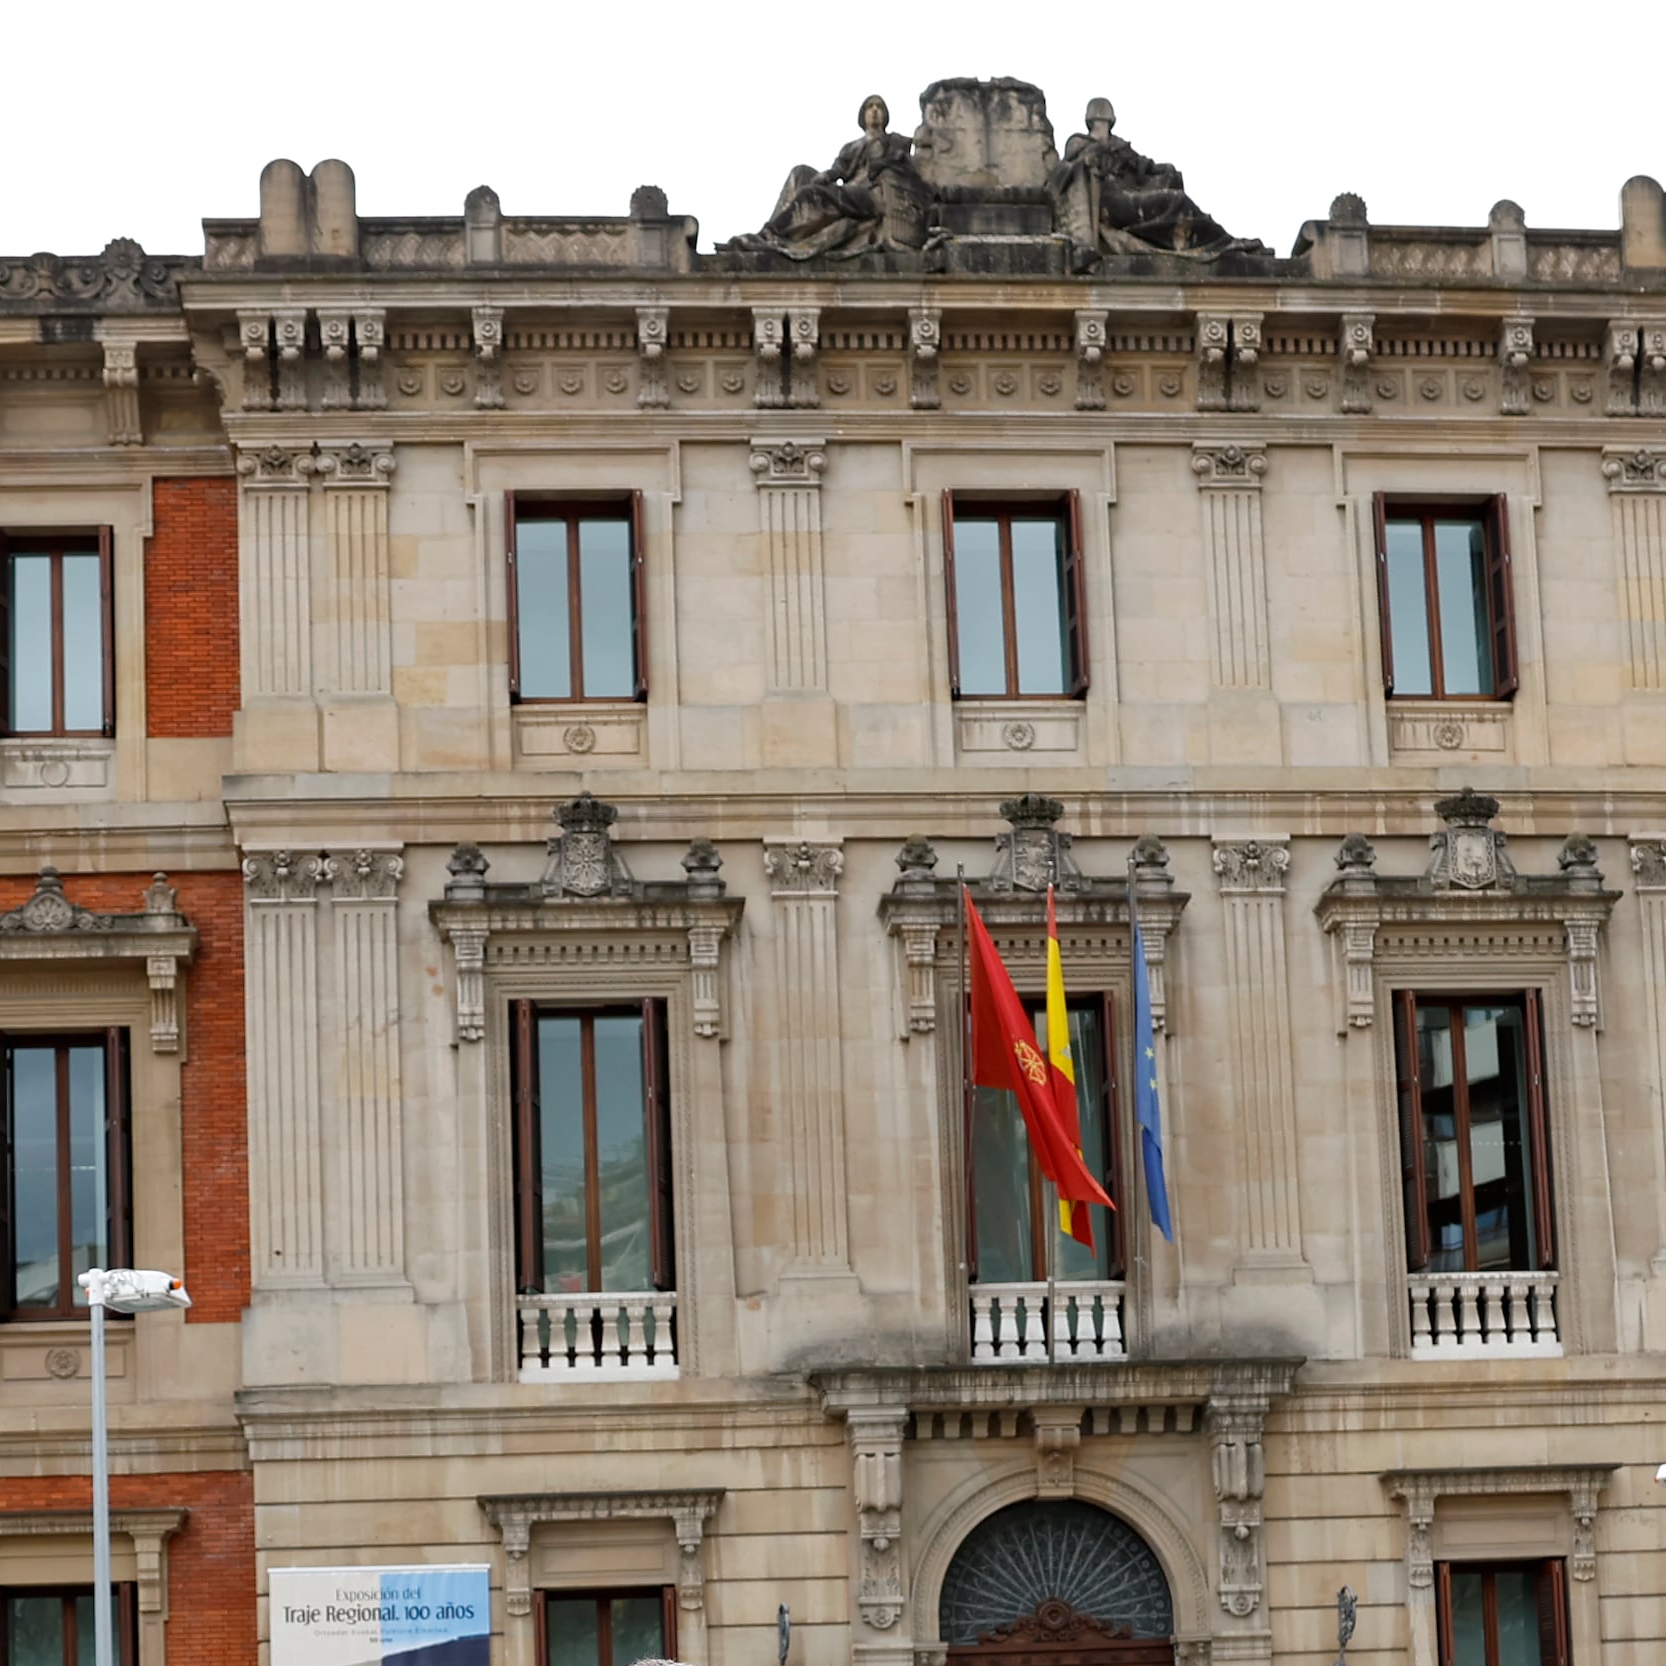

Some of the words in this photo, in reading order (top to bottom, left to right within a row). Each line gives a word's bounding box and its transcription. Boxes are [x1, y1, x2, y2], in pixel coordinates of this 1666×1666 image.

[335, 1587, 398, 1603] Exposición
[402, 1586, 422, 1600] del
[283, 1605, 321, 1626] Traje
[325, 1604, 400, 1625] Regional.
[404, 1605, 430, 1621] 100
[435, 1602, 475, 1621] años
